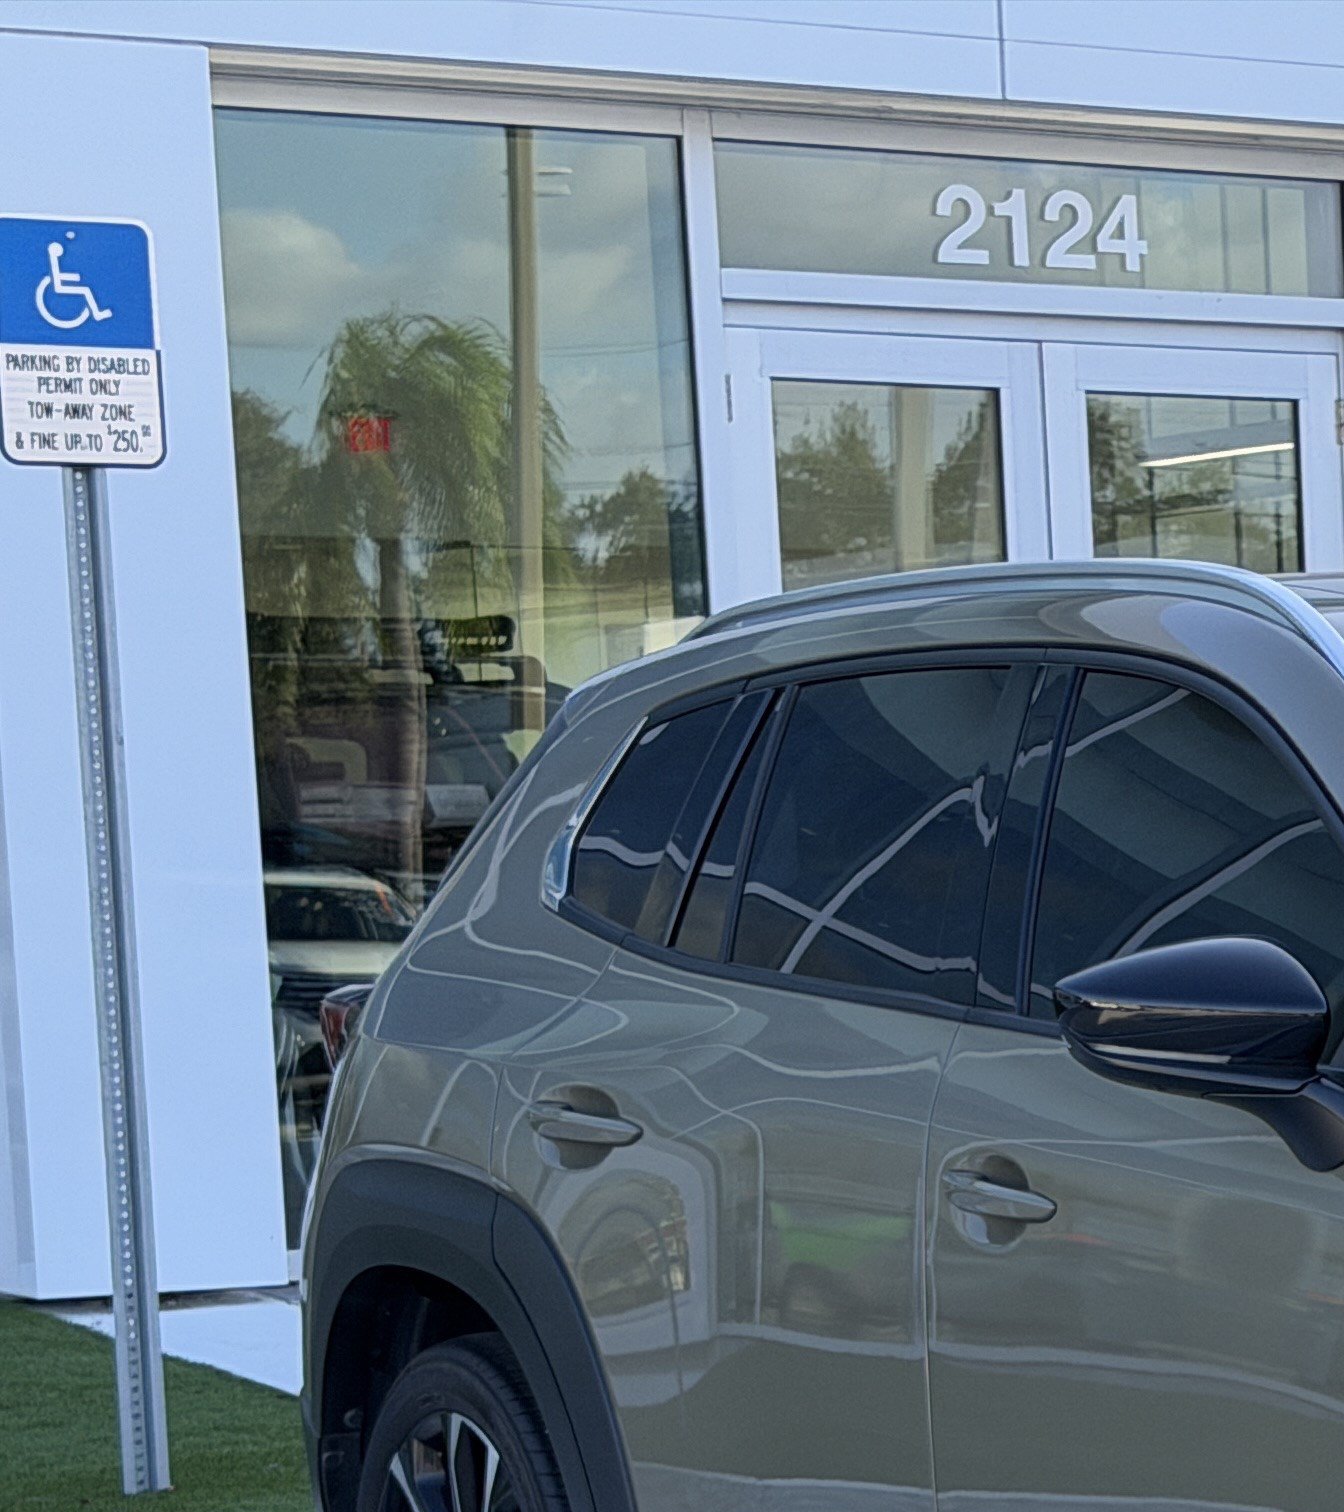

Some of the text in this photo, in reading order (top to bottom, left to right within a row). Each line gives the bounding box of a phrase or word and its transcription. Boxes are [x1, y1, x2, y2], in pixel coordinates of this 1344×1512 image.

[935, 183, 1149, 273] 2124
[5, 352, 151, 376] PARKING BY DISABLED
[36, 376, 122, 396] PERMIT ONLY
[27, 400, 136, 422] TOW-AWAY ZONE
[30, 432, 60, 451] FINE
[86, 433, 103, 453] TO
